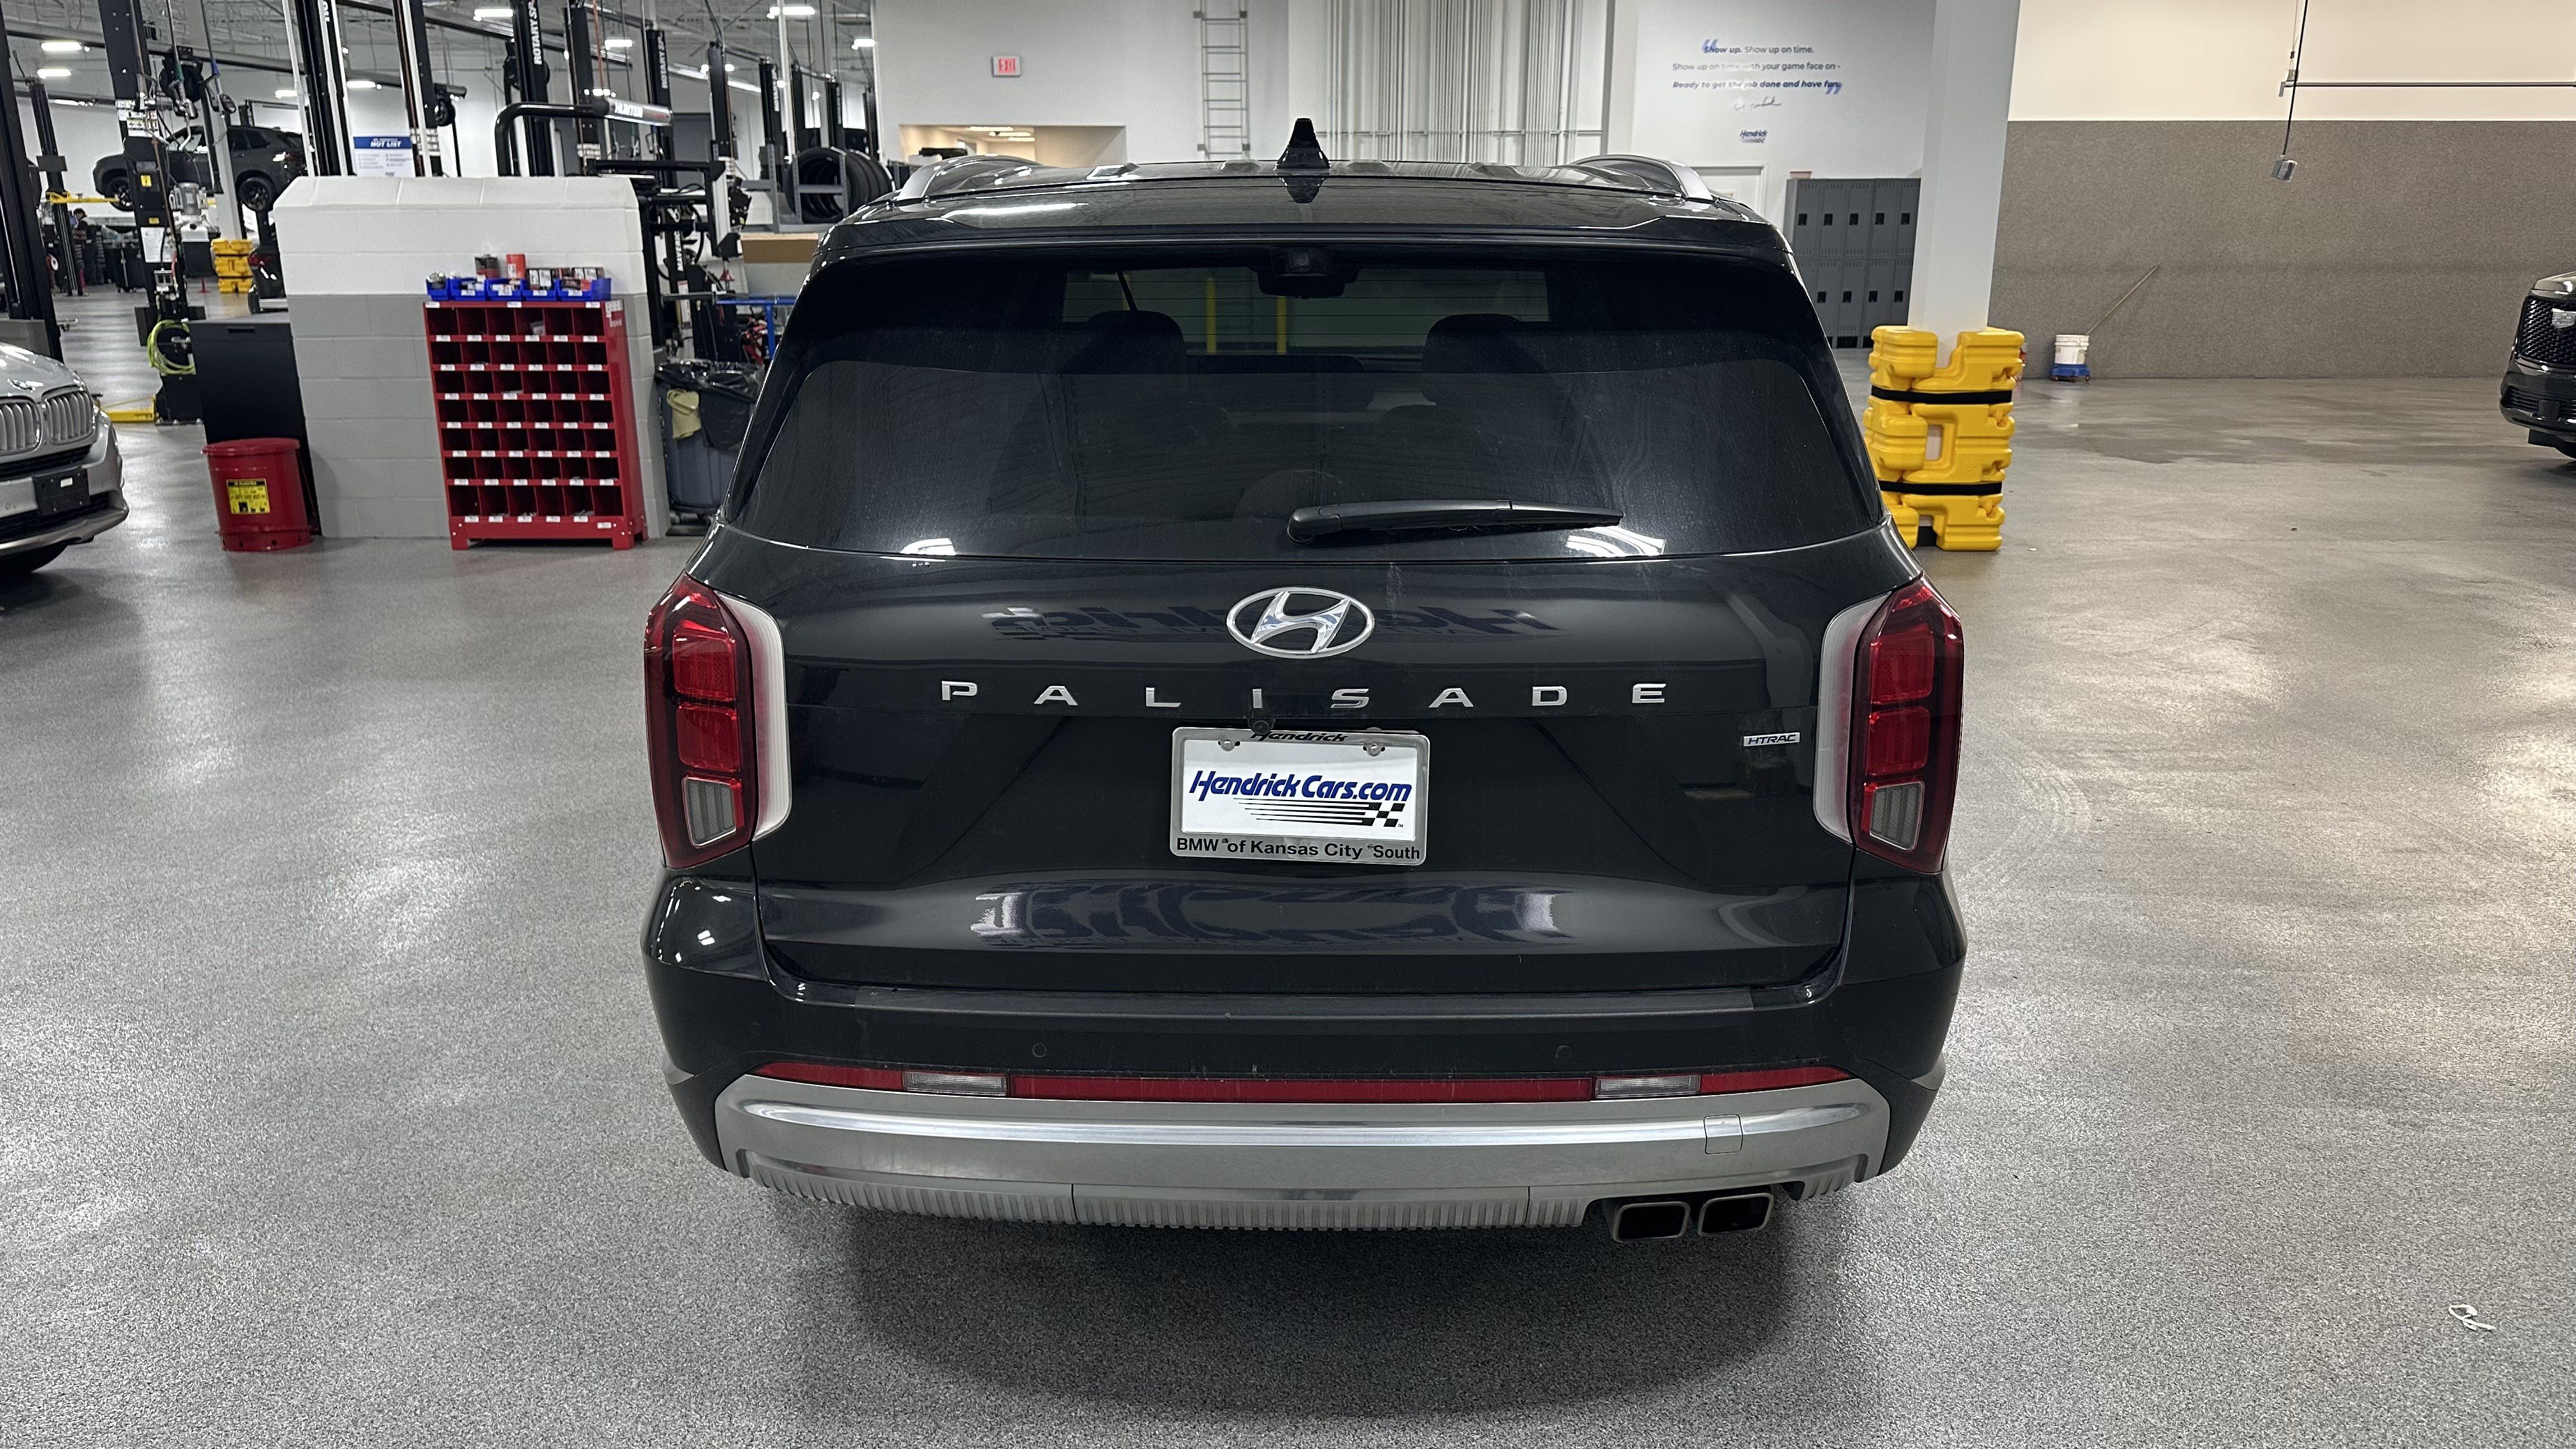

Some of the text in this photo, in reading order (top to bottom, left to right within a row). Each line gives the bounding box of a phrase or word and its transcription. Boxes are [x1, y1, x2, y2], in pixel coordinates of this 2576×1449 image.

[614, 100, 643, 118] HUNTER
[941, 680, 1667, 709] PALISADE
[1250, 731, 1348, 742] Hendrick
[1748, 734, 1797, 745] HTRAC
[1177, 838, 1420, 860] BMW of Kansas City South
